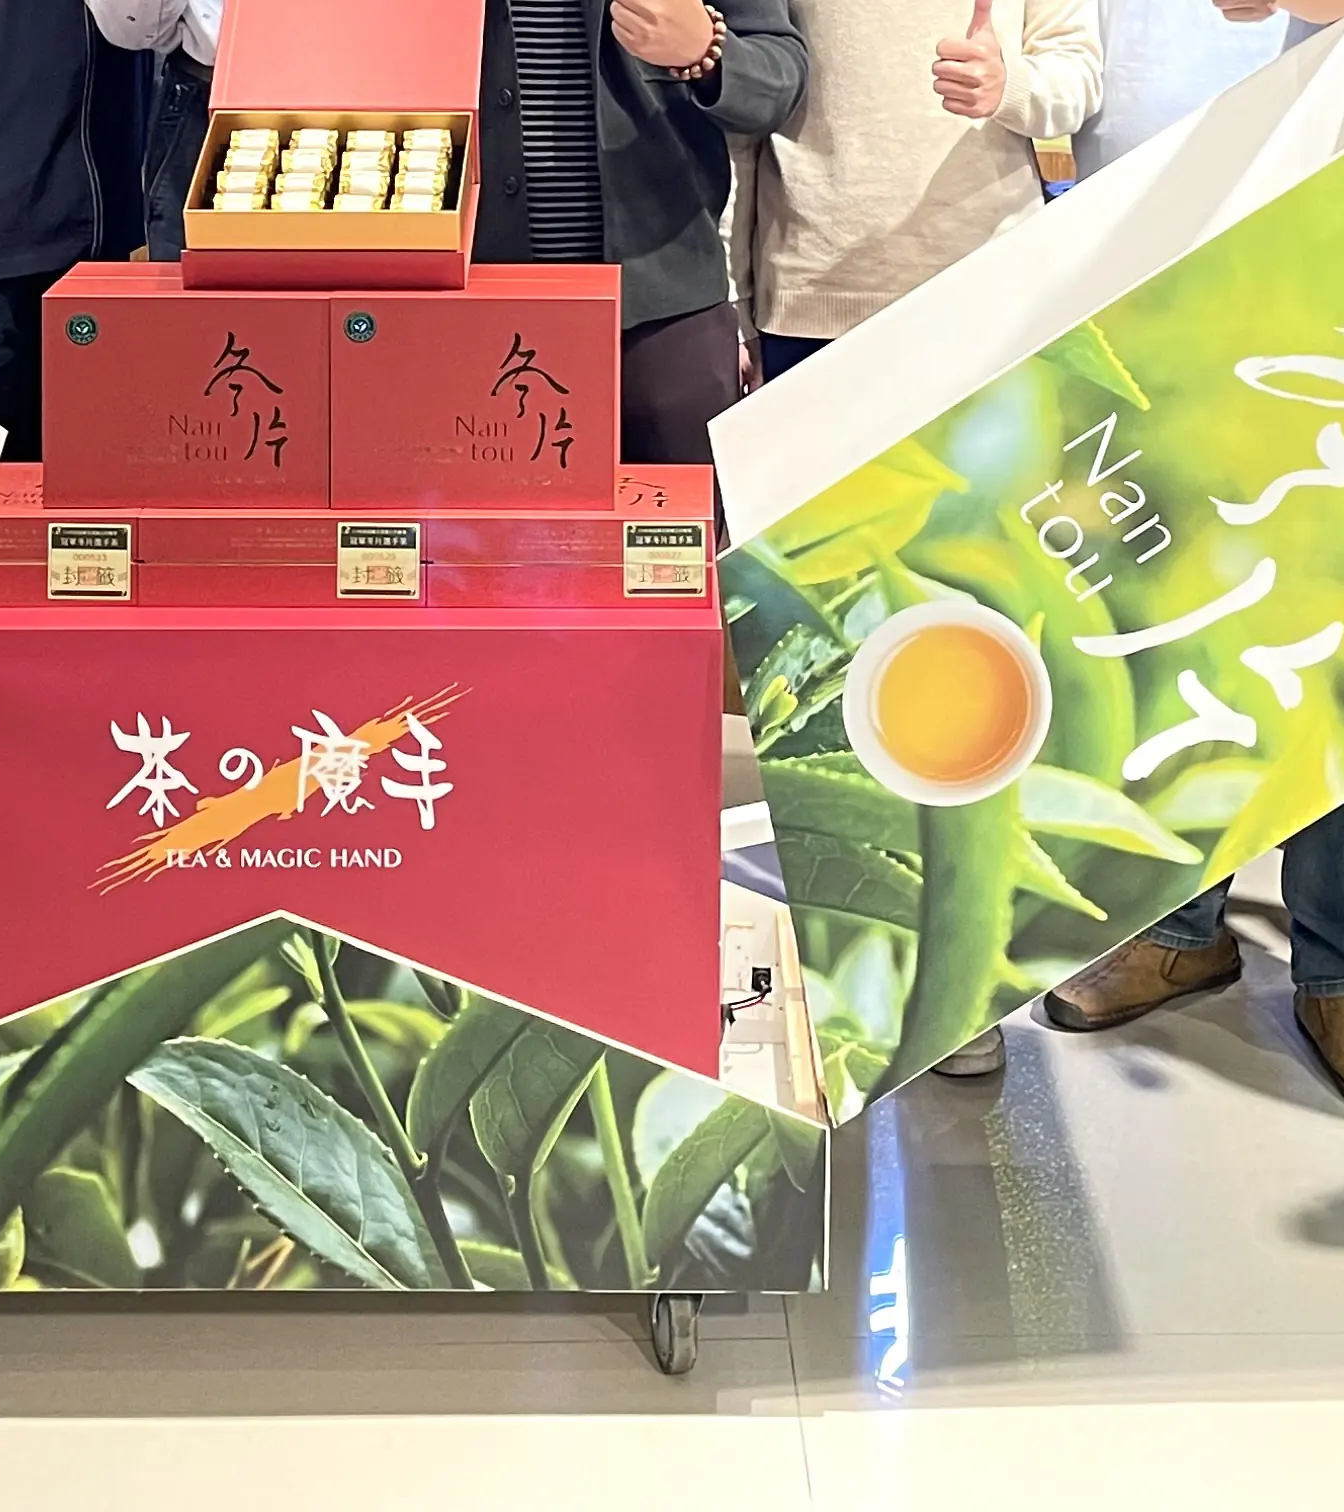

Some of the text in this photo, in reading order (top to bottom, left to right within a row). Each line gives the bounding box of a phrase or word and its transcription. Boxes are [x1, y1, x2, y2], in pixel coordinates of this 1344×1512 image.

[168, 414, 223, 437] Nan
[455, 414, 508, 437] Nan
[183, 442, 228, 462] tou
[470, 442, 514, 462] tou
[1063, 412, 1172, 564] Nan
[1020, 480, 1114, 604] tou
[105, 709, 454, 830] 茶の魔手
[164, 847, 403, 870] TEA & MAGIC HAND
